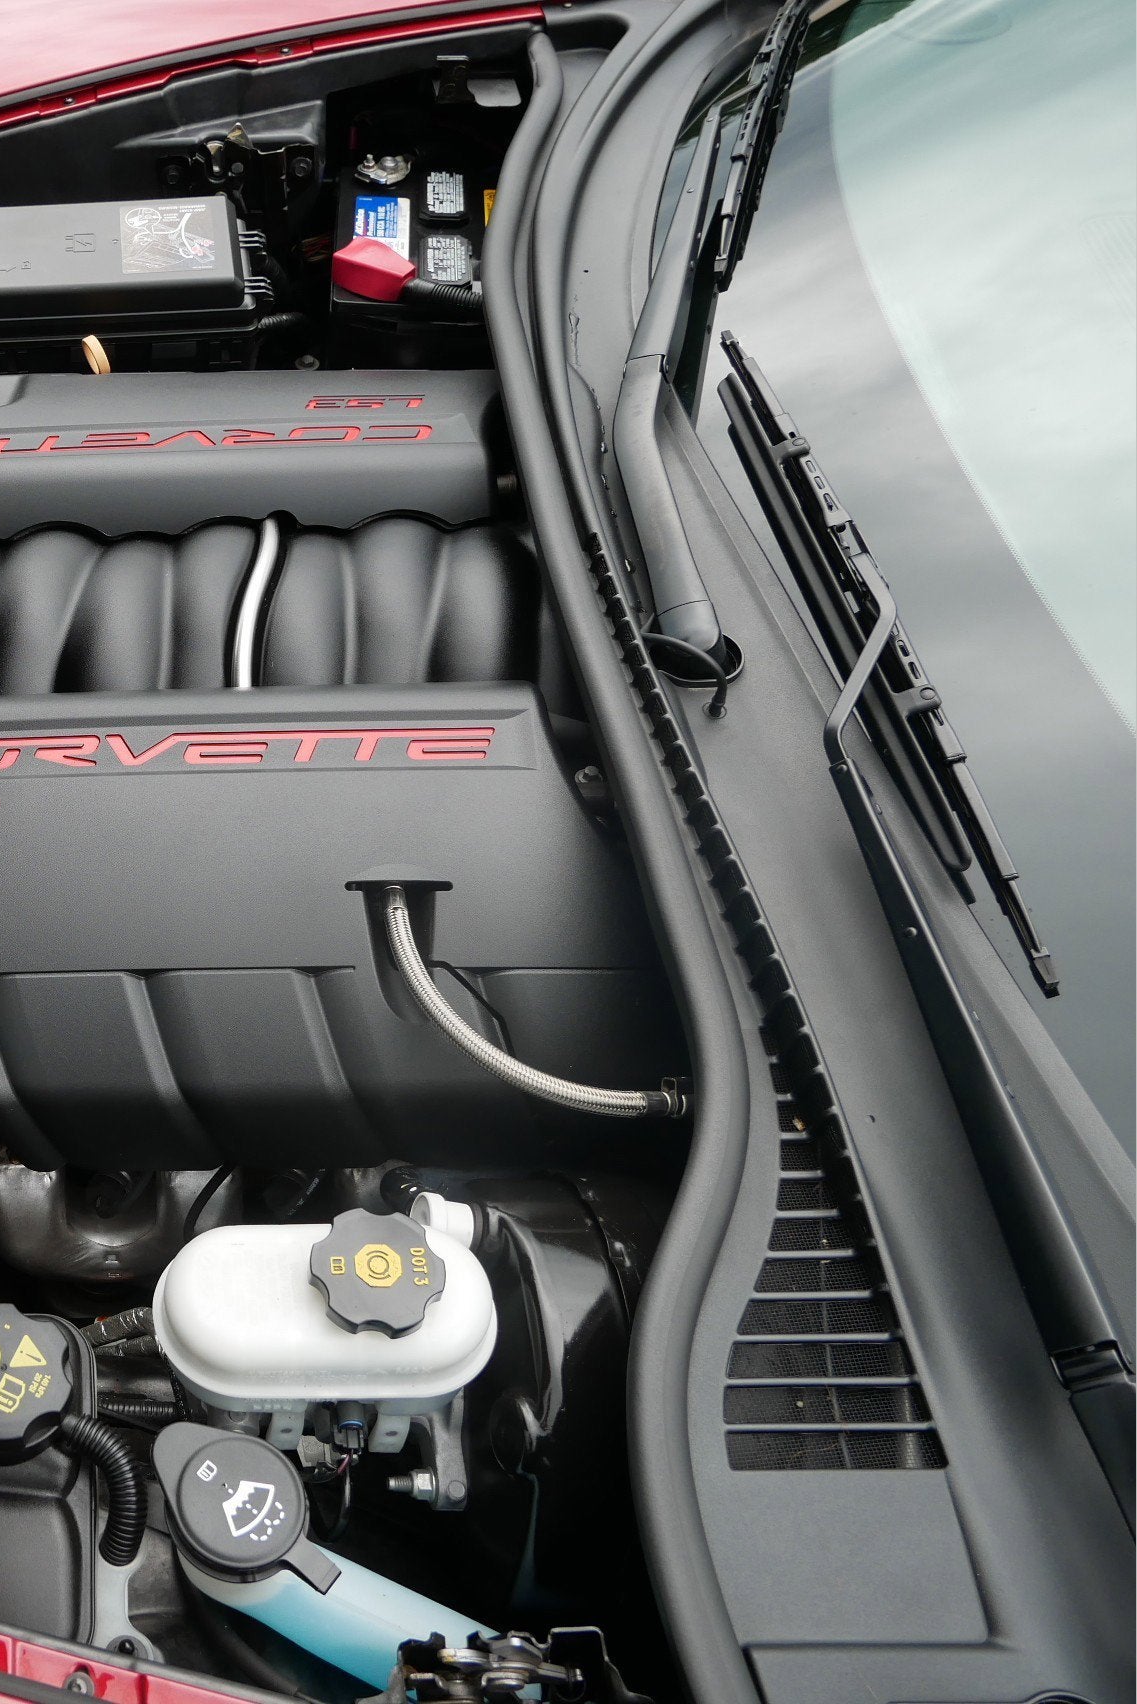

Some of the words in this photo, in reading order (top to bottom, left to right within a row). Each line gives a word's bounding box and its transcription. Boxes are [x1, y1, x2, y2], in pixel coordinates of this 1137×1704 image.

[305, 394, 426, 410] LS3
[410, 1247, 428, 1274] DOT
[414, 1277, 429, 1286] 3
